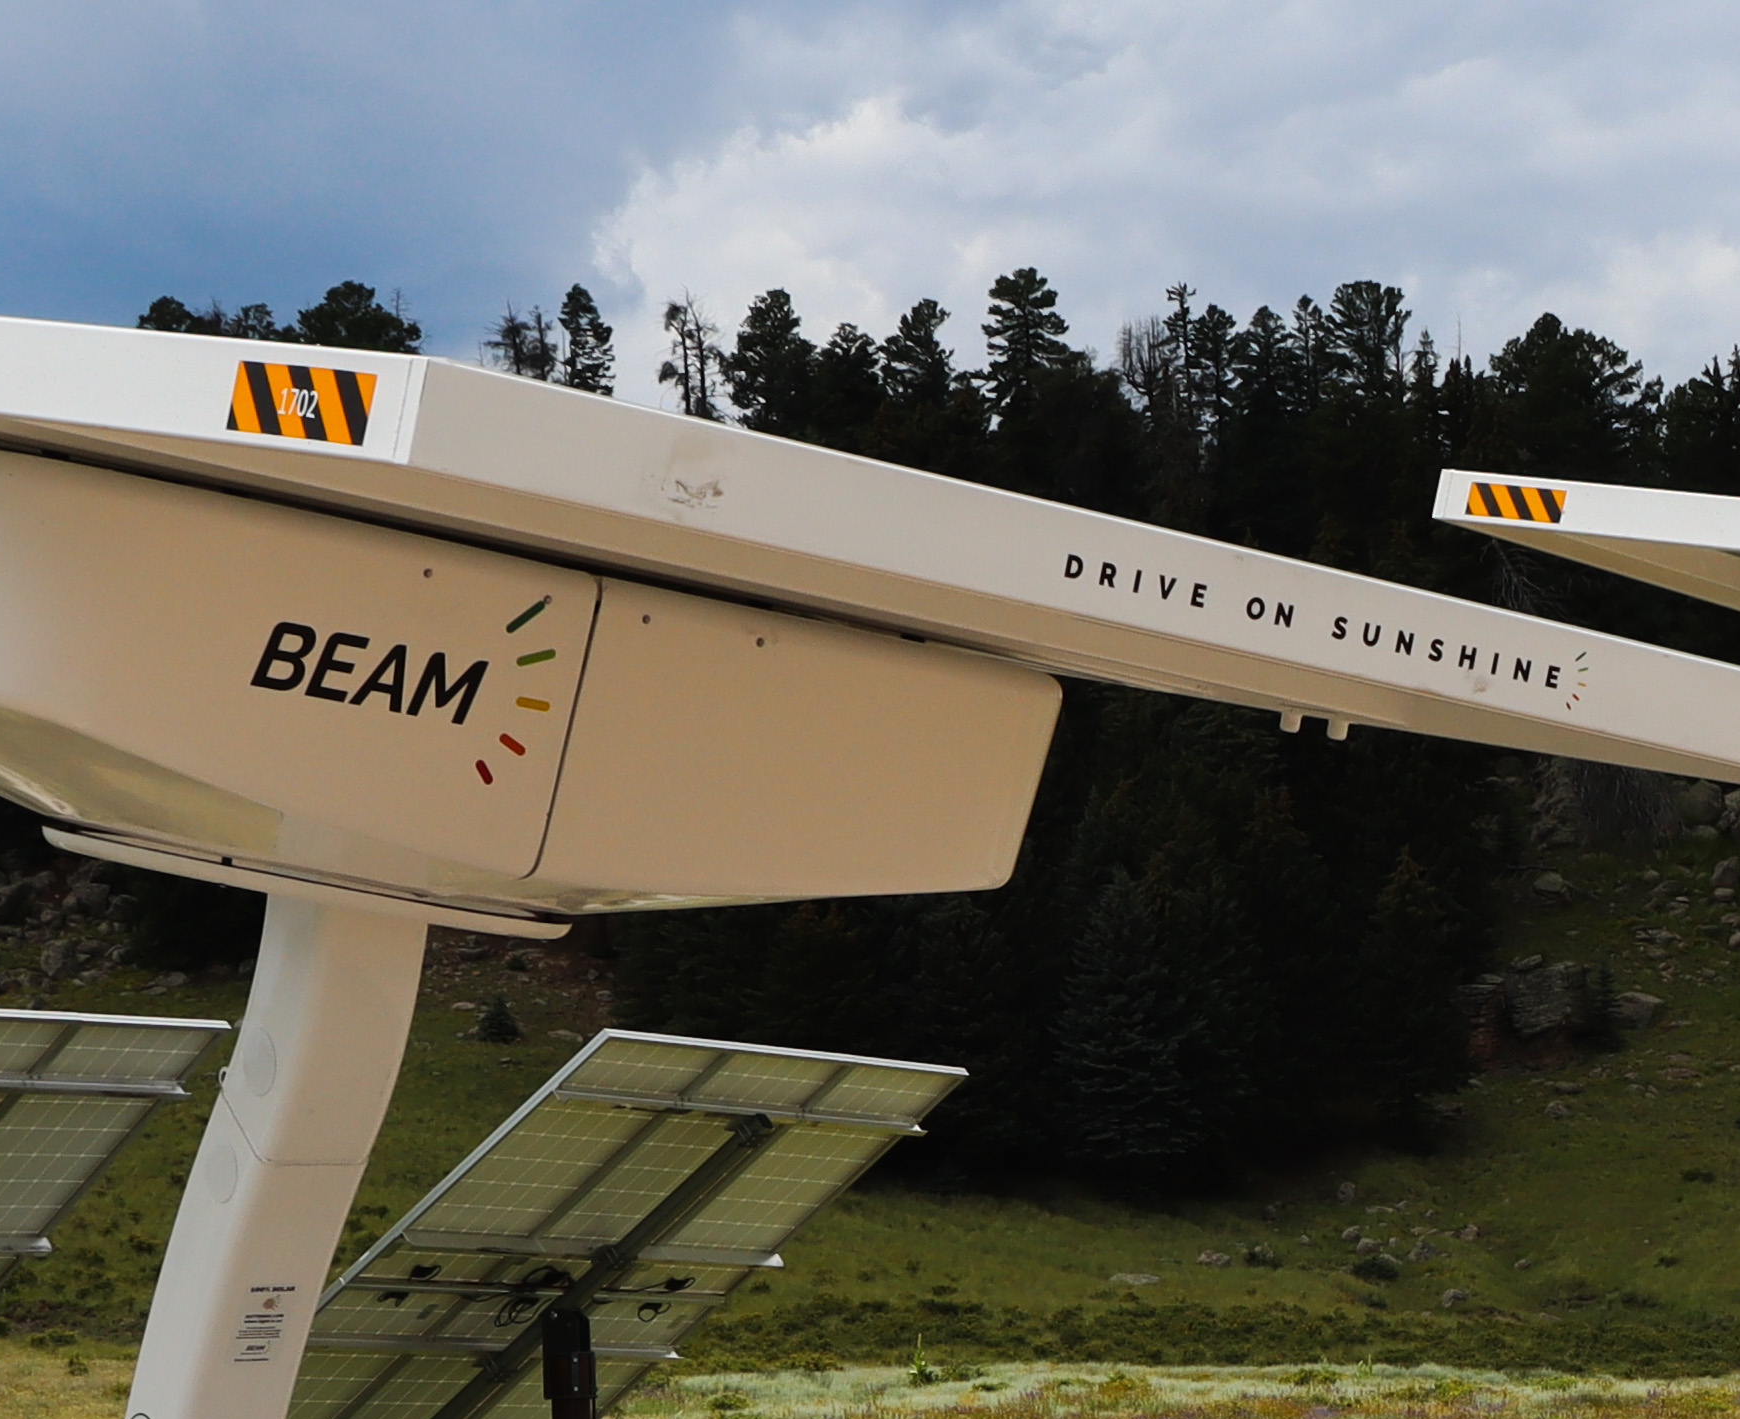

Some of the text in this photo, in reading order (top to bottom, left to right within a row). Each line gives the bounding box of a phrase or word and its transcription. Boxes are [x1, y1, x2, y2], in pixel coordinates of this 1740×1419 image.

[277, 388, 319, 419] 1702
[250, 621, 489, 725] BEAM
[1064, 554, 1561, 689] DRIVE ON SUNSHINE
